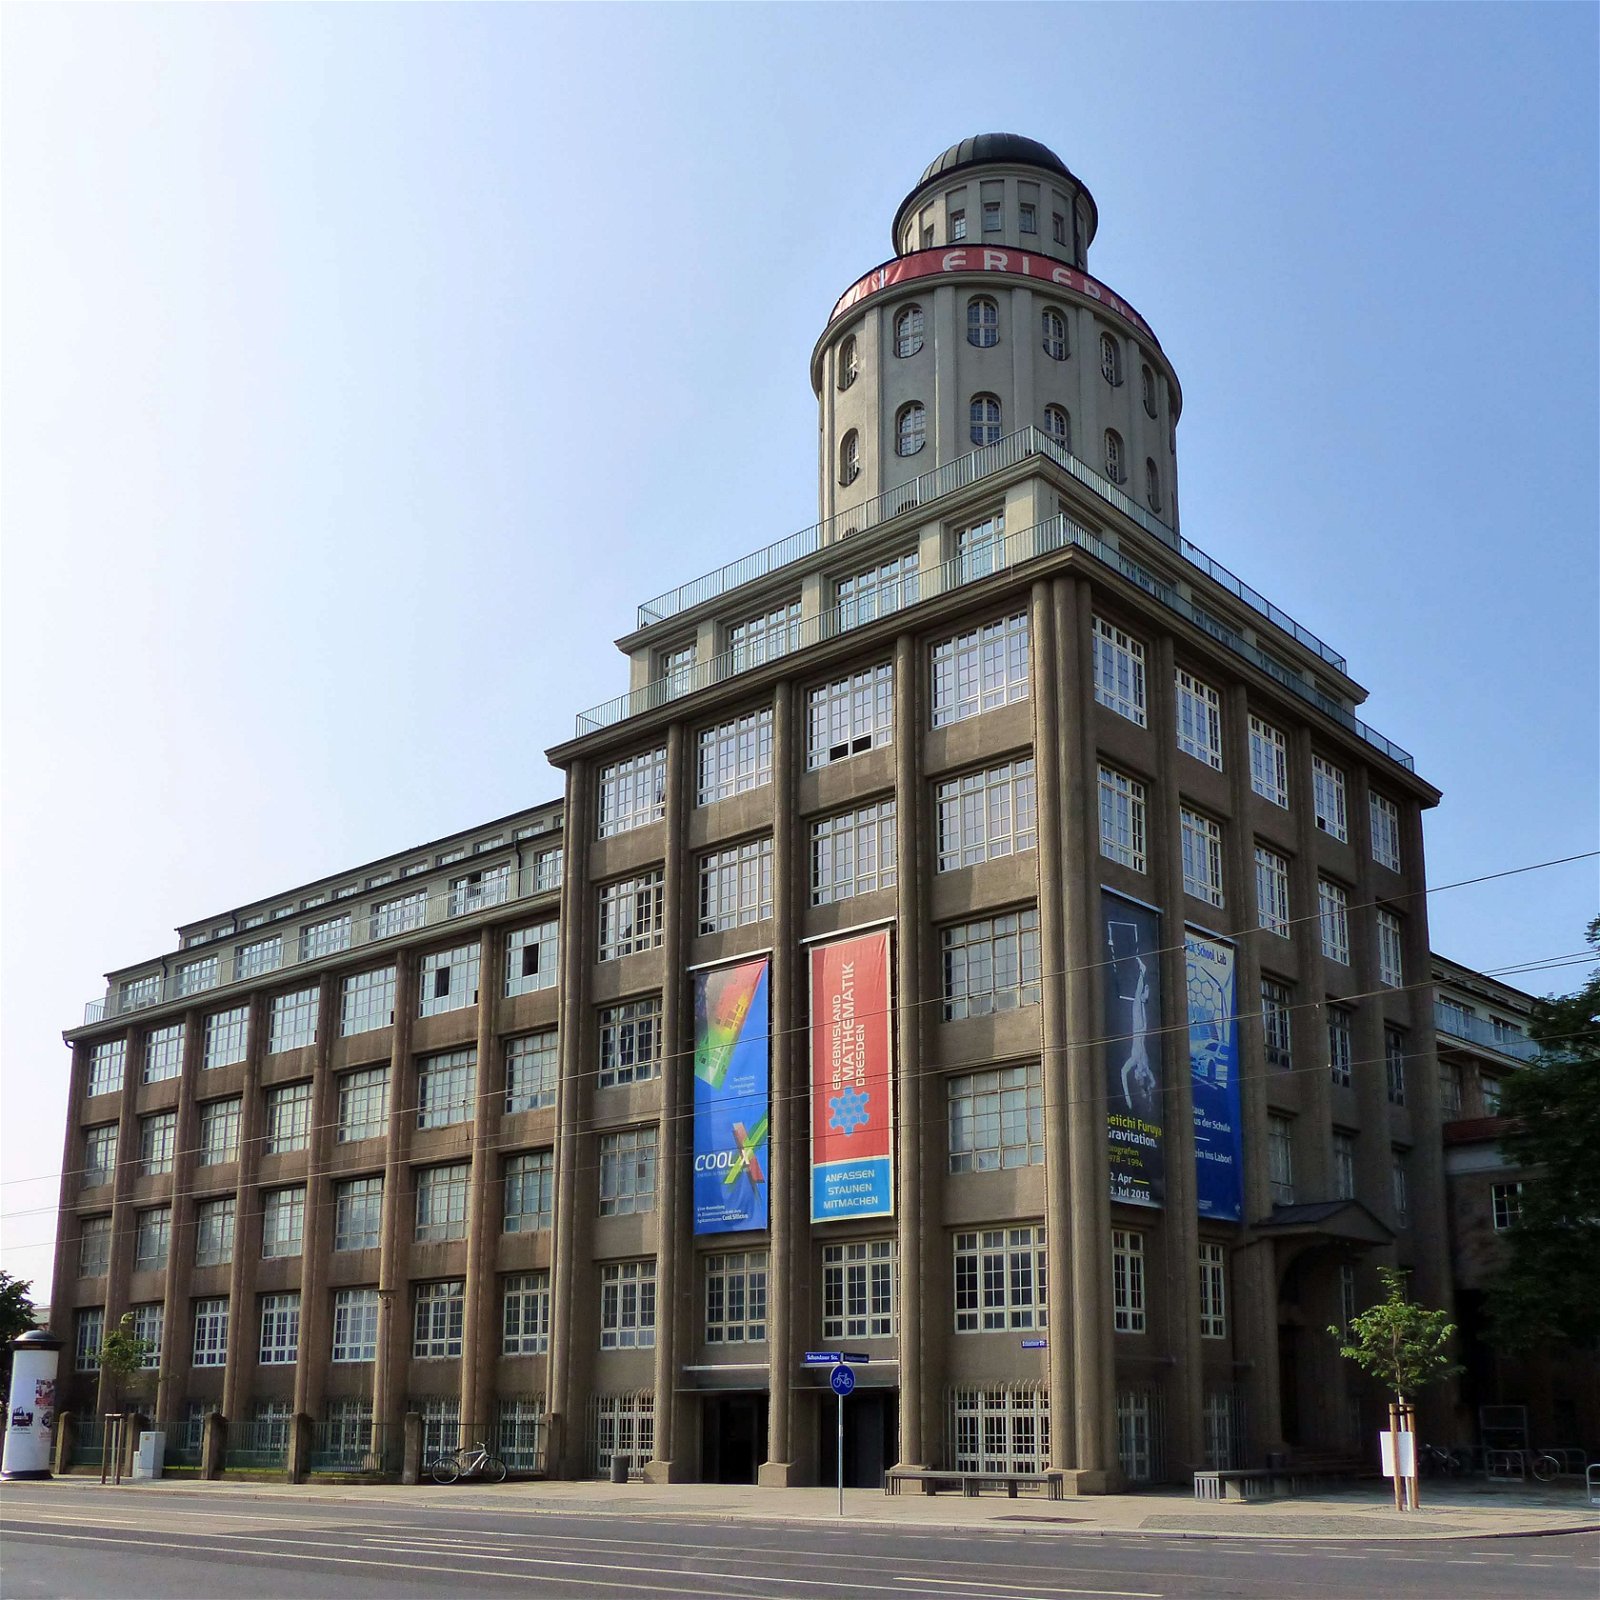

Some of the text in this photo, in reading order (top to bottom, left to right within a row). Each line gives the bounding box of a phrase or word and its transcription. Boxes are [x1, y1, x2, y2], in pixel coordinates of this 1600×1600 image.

[842, 960, 854, 1081] MATHEMATIK
[832, 994, 841, 1090] ERLEBNISLAND
[856, 1024, 865, 1087] DRESDEN
[1137, 1119, 1162, 1138] Furuya
[1212, 1121, 1231, 1133] Schule
[825, 1169, 875, 1183] ANFASSEN
[1117, 1172, 1132, 1185] Apr
[827, 1183, 873, 1196] STAUNEN
[1118, 1186, 1129, 1197] Jul
[1131, 1189, 1150, 1201] 2015
[823, 1196, 878, 1209] MITMACHEN
